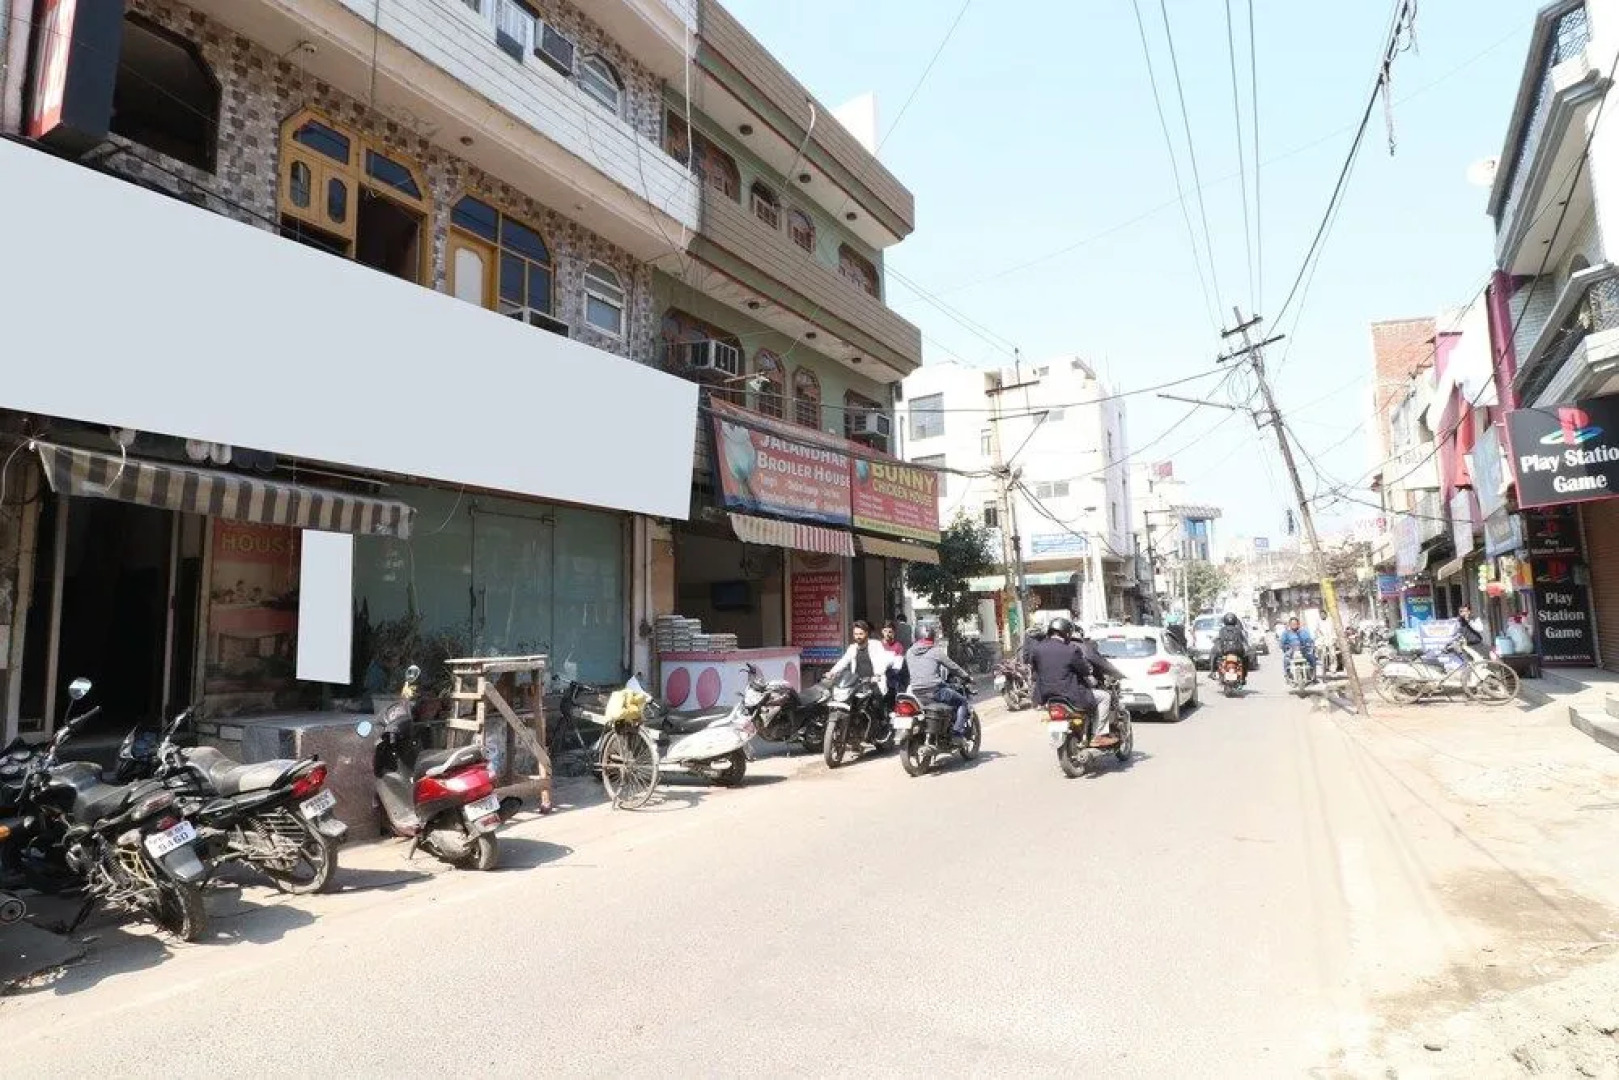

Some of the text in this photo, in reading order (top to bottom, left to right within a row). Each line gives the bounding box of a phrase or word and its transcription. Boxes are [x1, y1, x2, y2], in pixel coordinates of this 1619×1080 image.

[760, 435, 848, 468] JALANDHAR
[757, 451, 851, 489] BROILER HOUSE
[1519, 454, 1560, 474] Play
[869, 461, 936, 495] BUNNY
[1553, 474, 1608, 493] Game
[1545, 592, 1573, 606] Play
[1537, 610, 1585, 622] Station
[1545, 626, 1583, 639] Game
